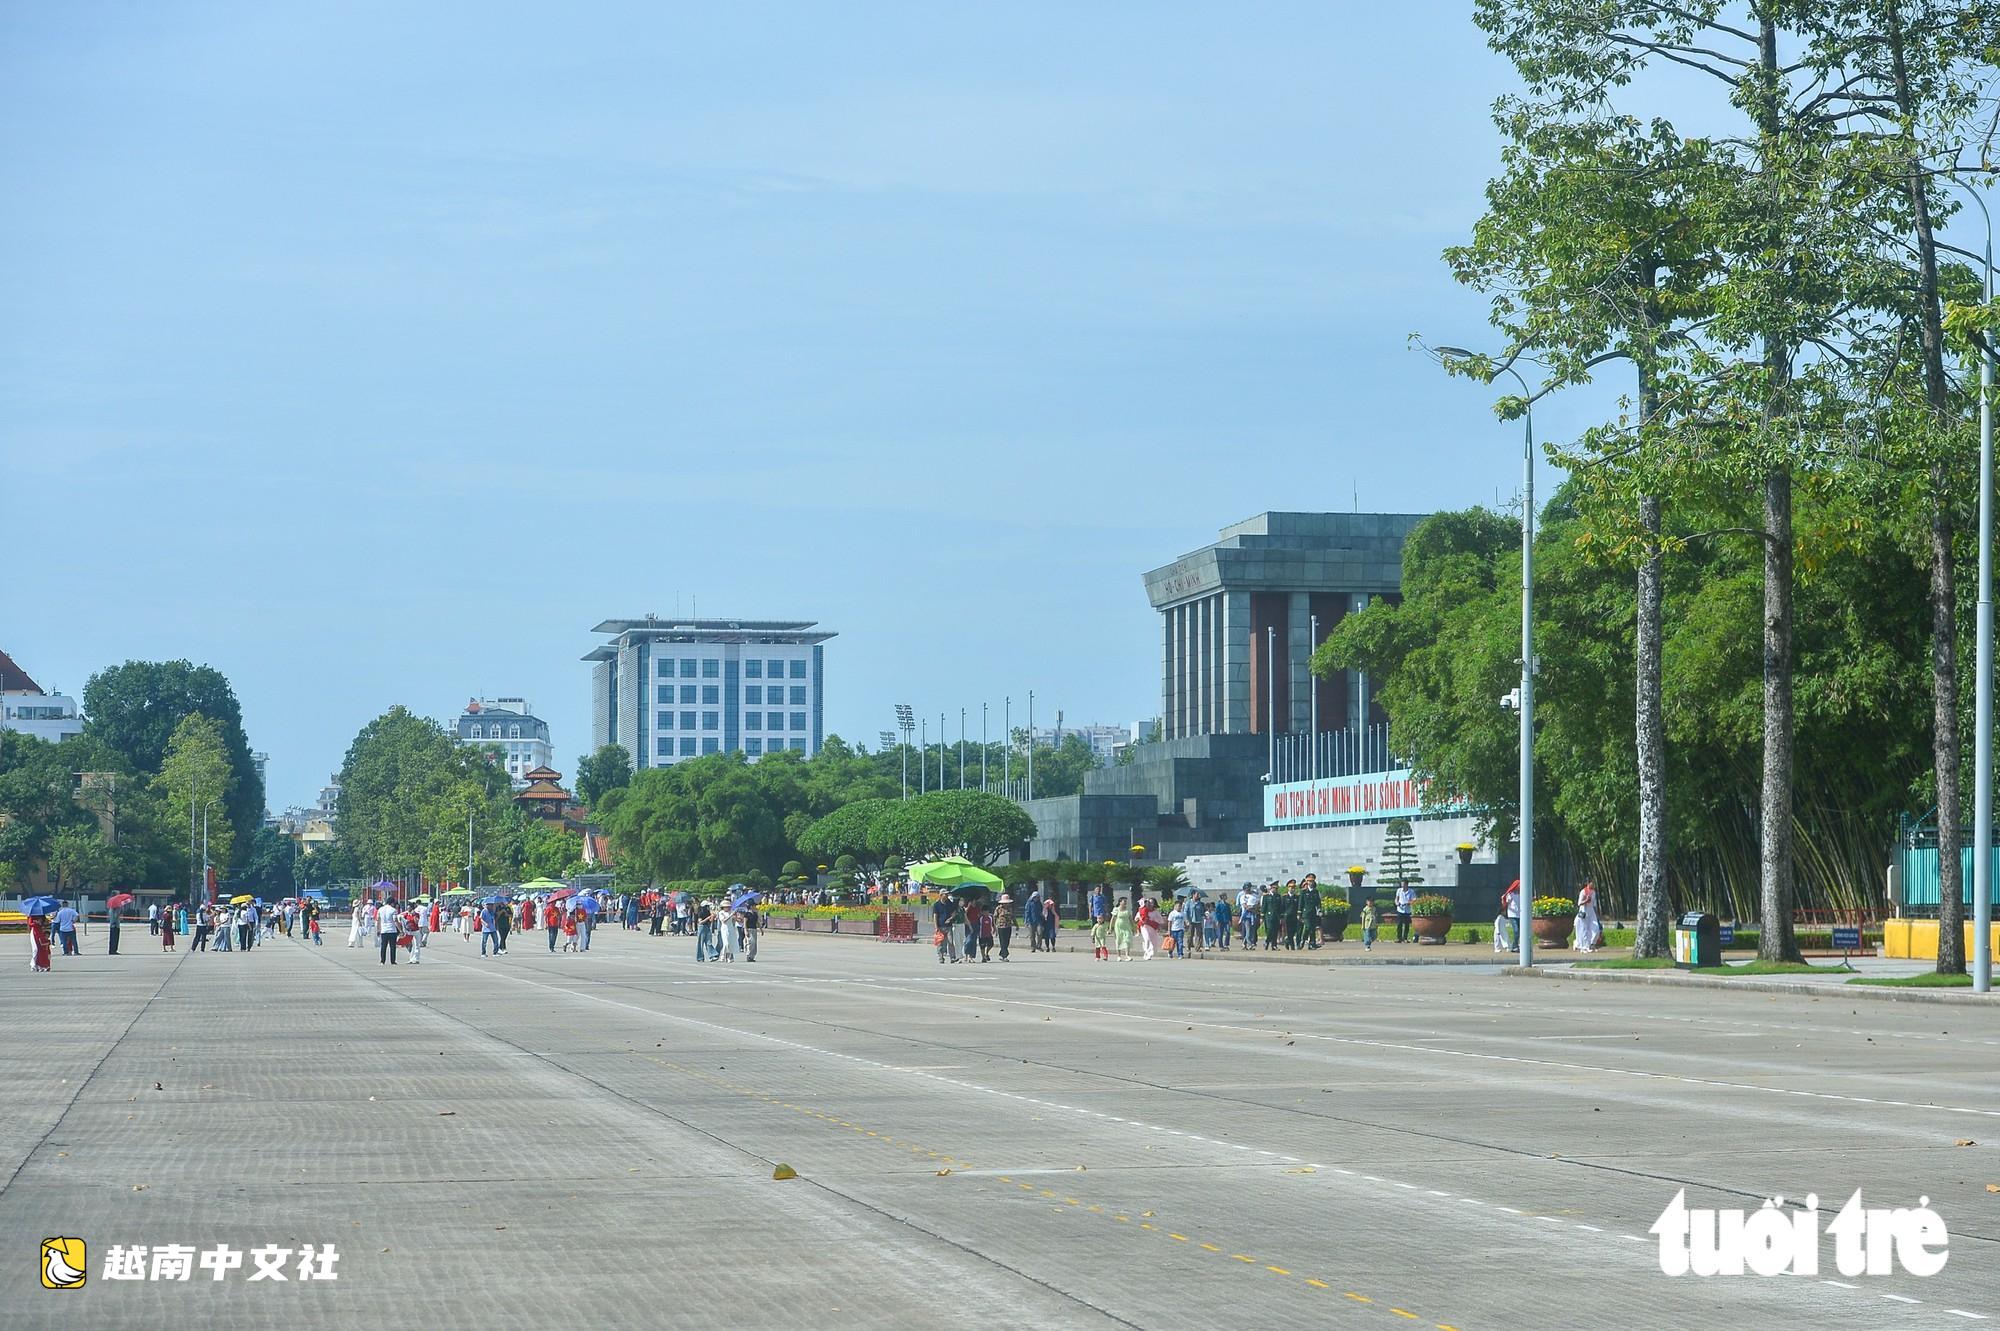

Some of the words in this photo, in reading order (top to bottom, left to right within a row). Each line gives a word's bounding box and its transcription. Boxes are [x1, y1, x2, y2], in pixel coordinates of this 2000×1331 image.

[1290, 791, 1304, 823] TỊCH
[1332, 785, 1350, 814] MINH
[1380, 771, 1400, 810] SỐNG
